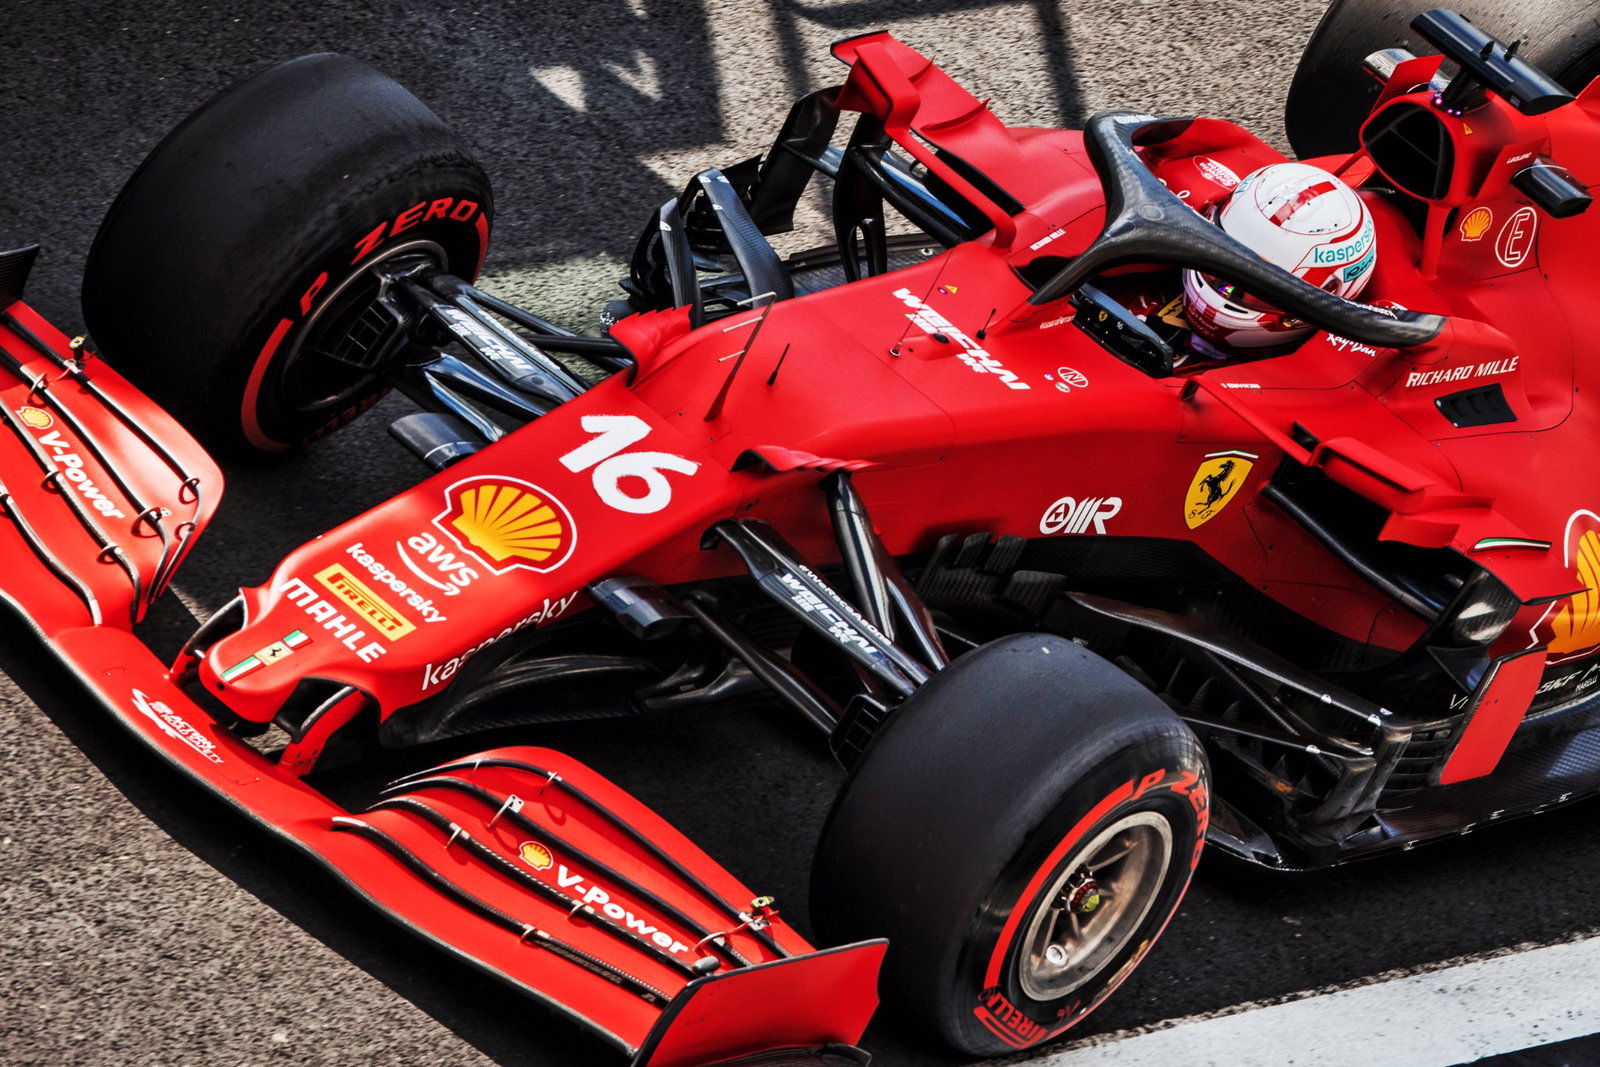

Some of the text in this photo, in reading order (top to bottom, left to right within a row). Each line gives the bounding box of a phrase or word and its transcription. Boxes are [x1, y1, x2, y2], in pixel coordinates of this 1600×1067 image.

[301, 197, 479, 316] P ZERO
[892, 287, 1031, 390] WEICHAI
[1405, 356, 1519, 388] RICHARD MILLE
[38, 429, 127, 520] V-Power
[558, 414, 702, 514] 16
[345, 542, 448, 623] kaspersky
[407, 531, 480, 588] aws
[278, 577, 387, 664] MAHLE
[326, 571, 403, 632] PIRELLI
[782, 572, 878, 654] WEICHAI
[1130, 768, 1166, 801] P
[556, 864, 690, 955] V-Power
[973, 992, 1048, 1049] PIRELLI
